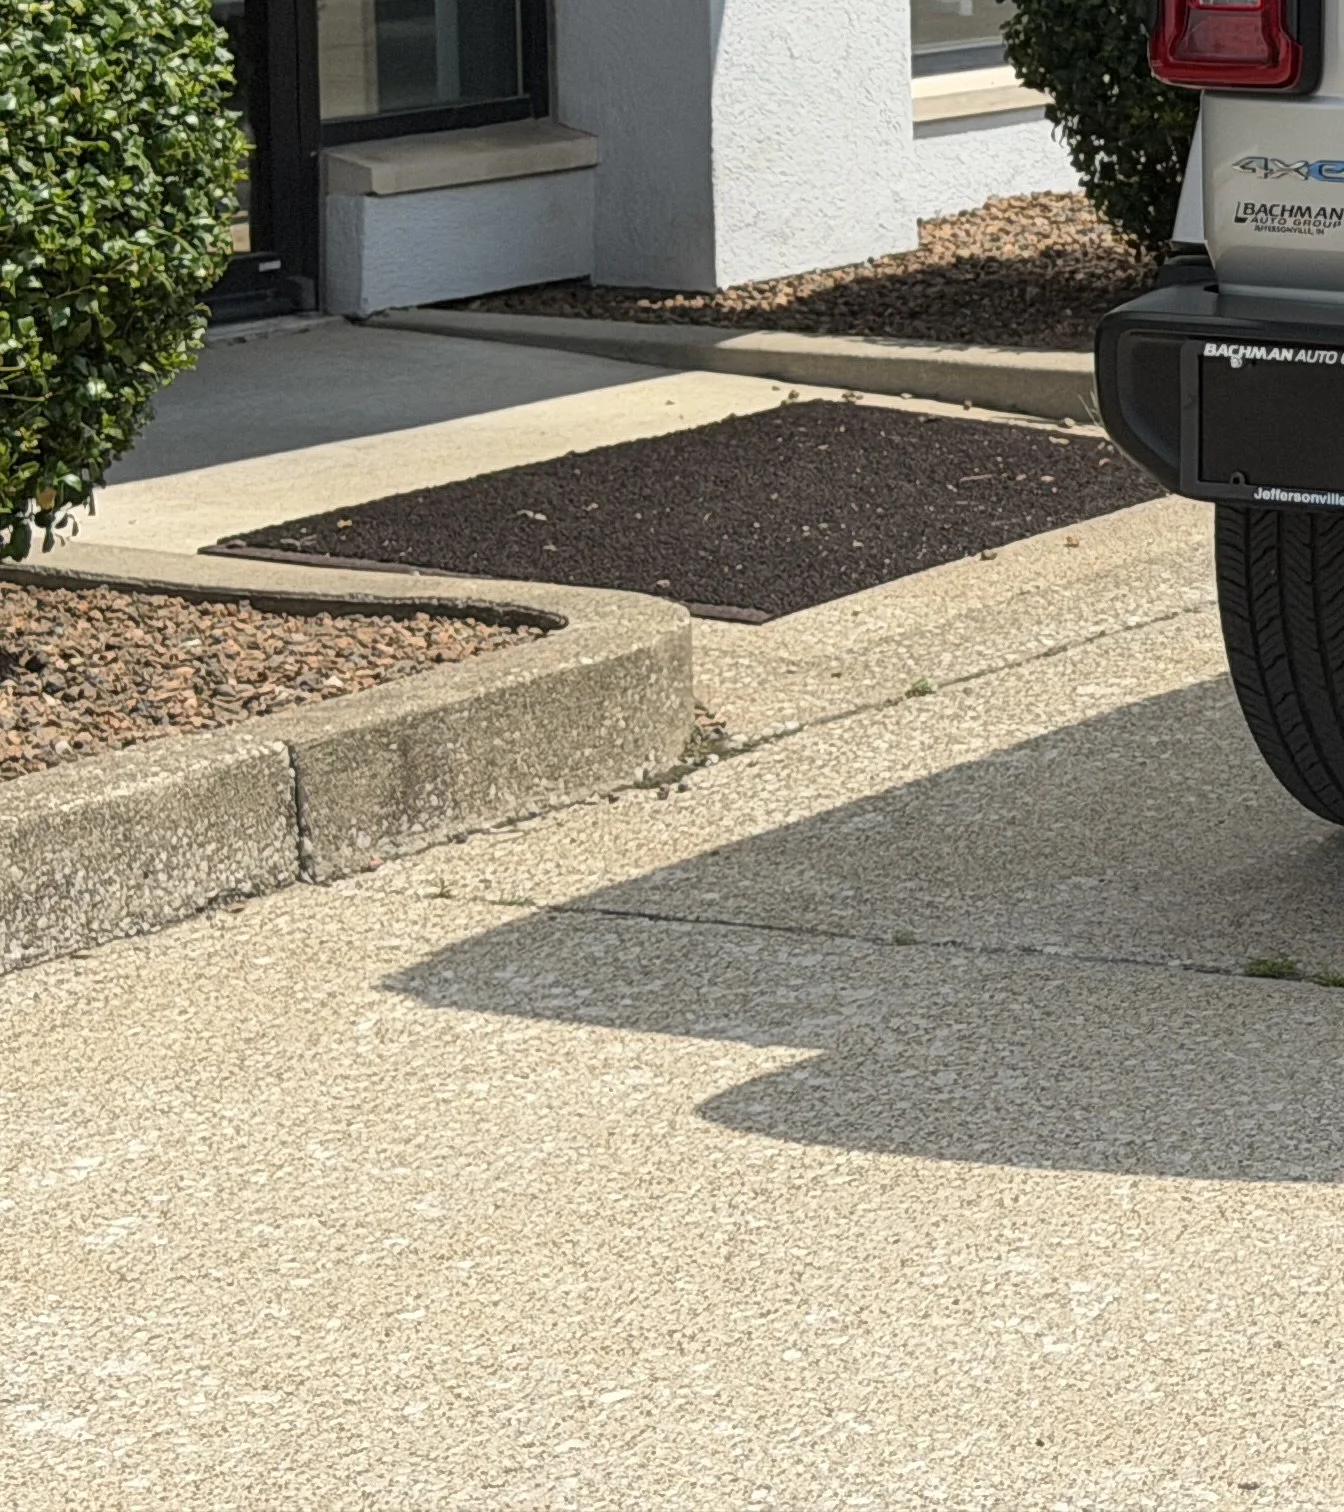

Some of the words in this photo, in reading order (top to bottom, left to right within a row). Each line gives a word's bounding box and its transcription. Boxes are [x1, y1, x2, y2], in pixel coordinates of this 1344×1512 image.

[1243, 201, 1344, 220] BACHMAN
[1250, 215, 1287, 226] AUTO
[1293, 218, 1342, 229] GROUP
[1203, 342, 1293, 362] BACHMAN
[1294, 349, 1337, 365] AUTO
